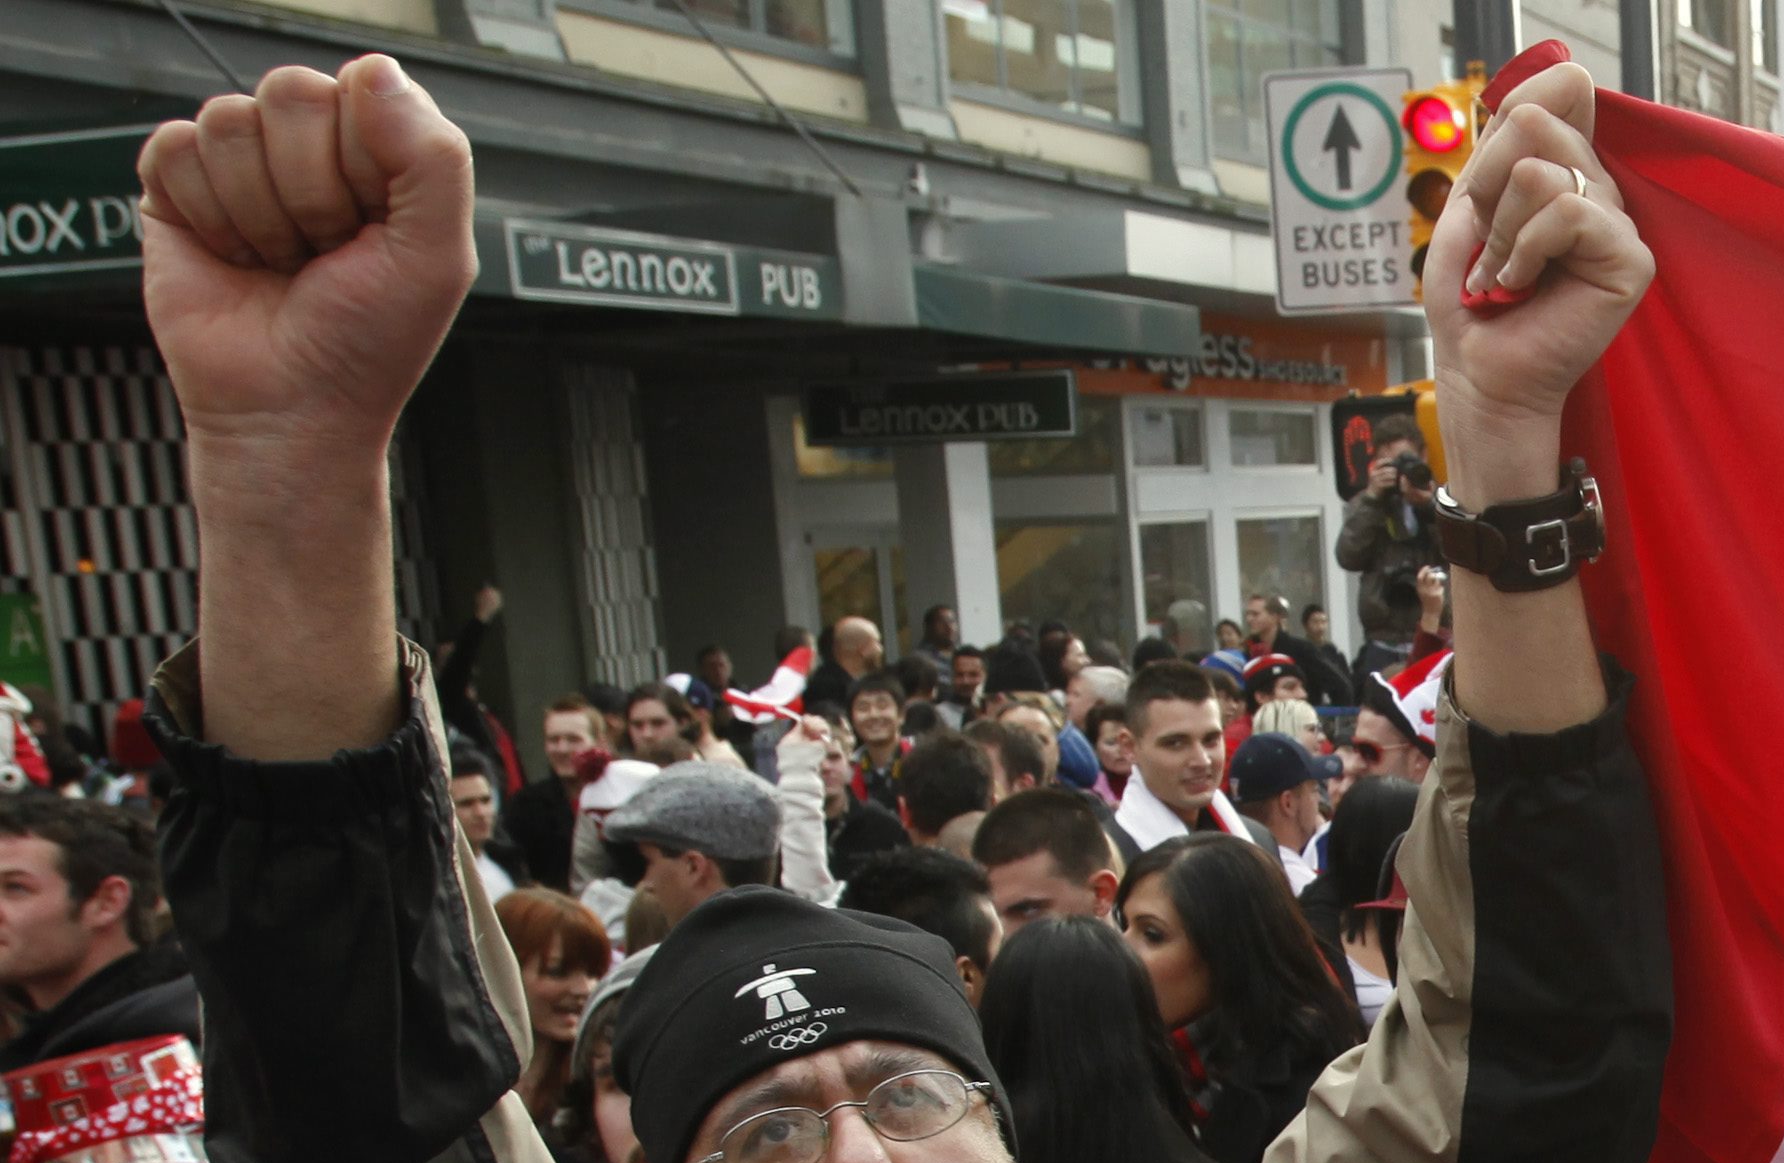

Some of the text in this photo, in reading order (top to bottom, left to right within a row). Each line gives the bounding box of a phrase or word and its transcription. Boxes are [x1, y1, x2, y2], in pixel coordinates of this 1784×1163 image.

[1293, 220, 1401, 252] EXCEPT
[555, 240, 718, 298] Lennox
[759, 262, 822, 310] PUB
[1302, 257, 1399, 289] BUSES
[976, 402, 1040, 431] PUB
[813, 1005, 846, 1018] 2010
